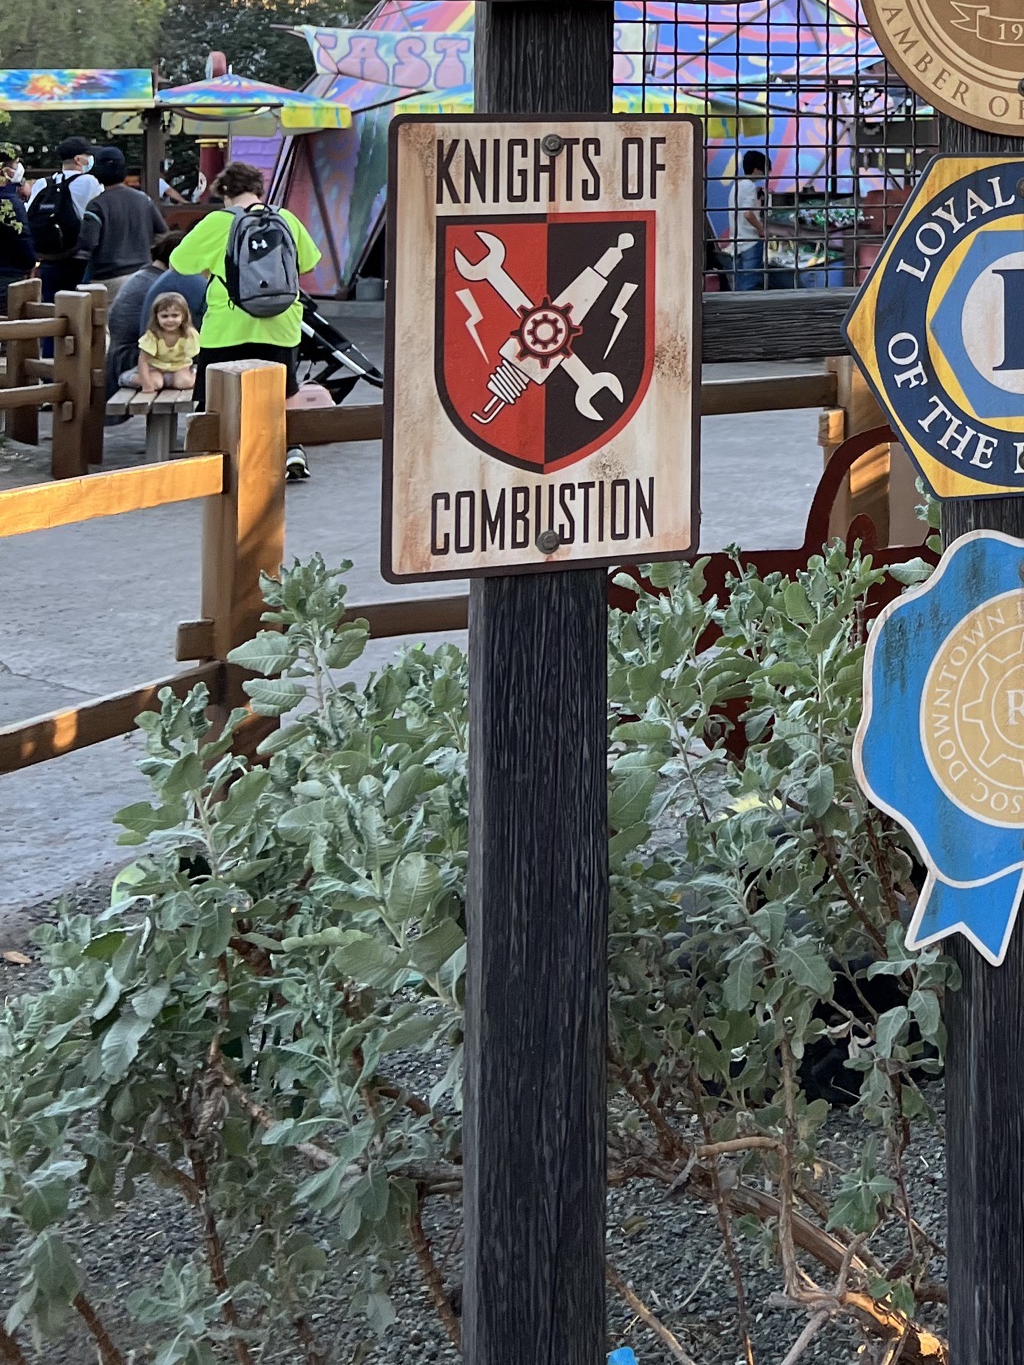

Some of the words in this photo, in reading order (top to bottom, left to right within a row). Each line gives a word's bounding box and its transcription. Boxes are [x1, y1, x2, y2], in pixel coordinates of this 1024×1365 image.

[436, 137, 601, 204] KNIGHTS
[621, 137, 666, 201] OF
[896, 176, 1016, 282] LOYAL
[888, 332, 930, 389] OF
[917, 395, 999, 469] THE
[430, 476, 655, 556] COMBUSTION
[932, 607, 1006, 783] DOWNTOWN
